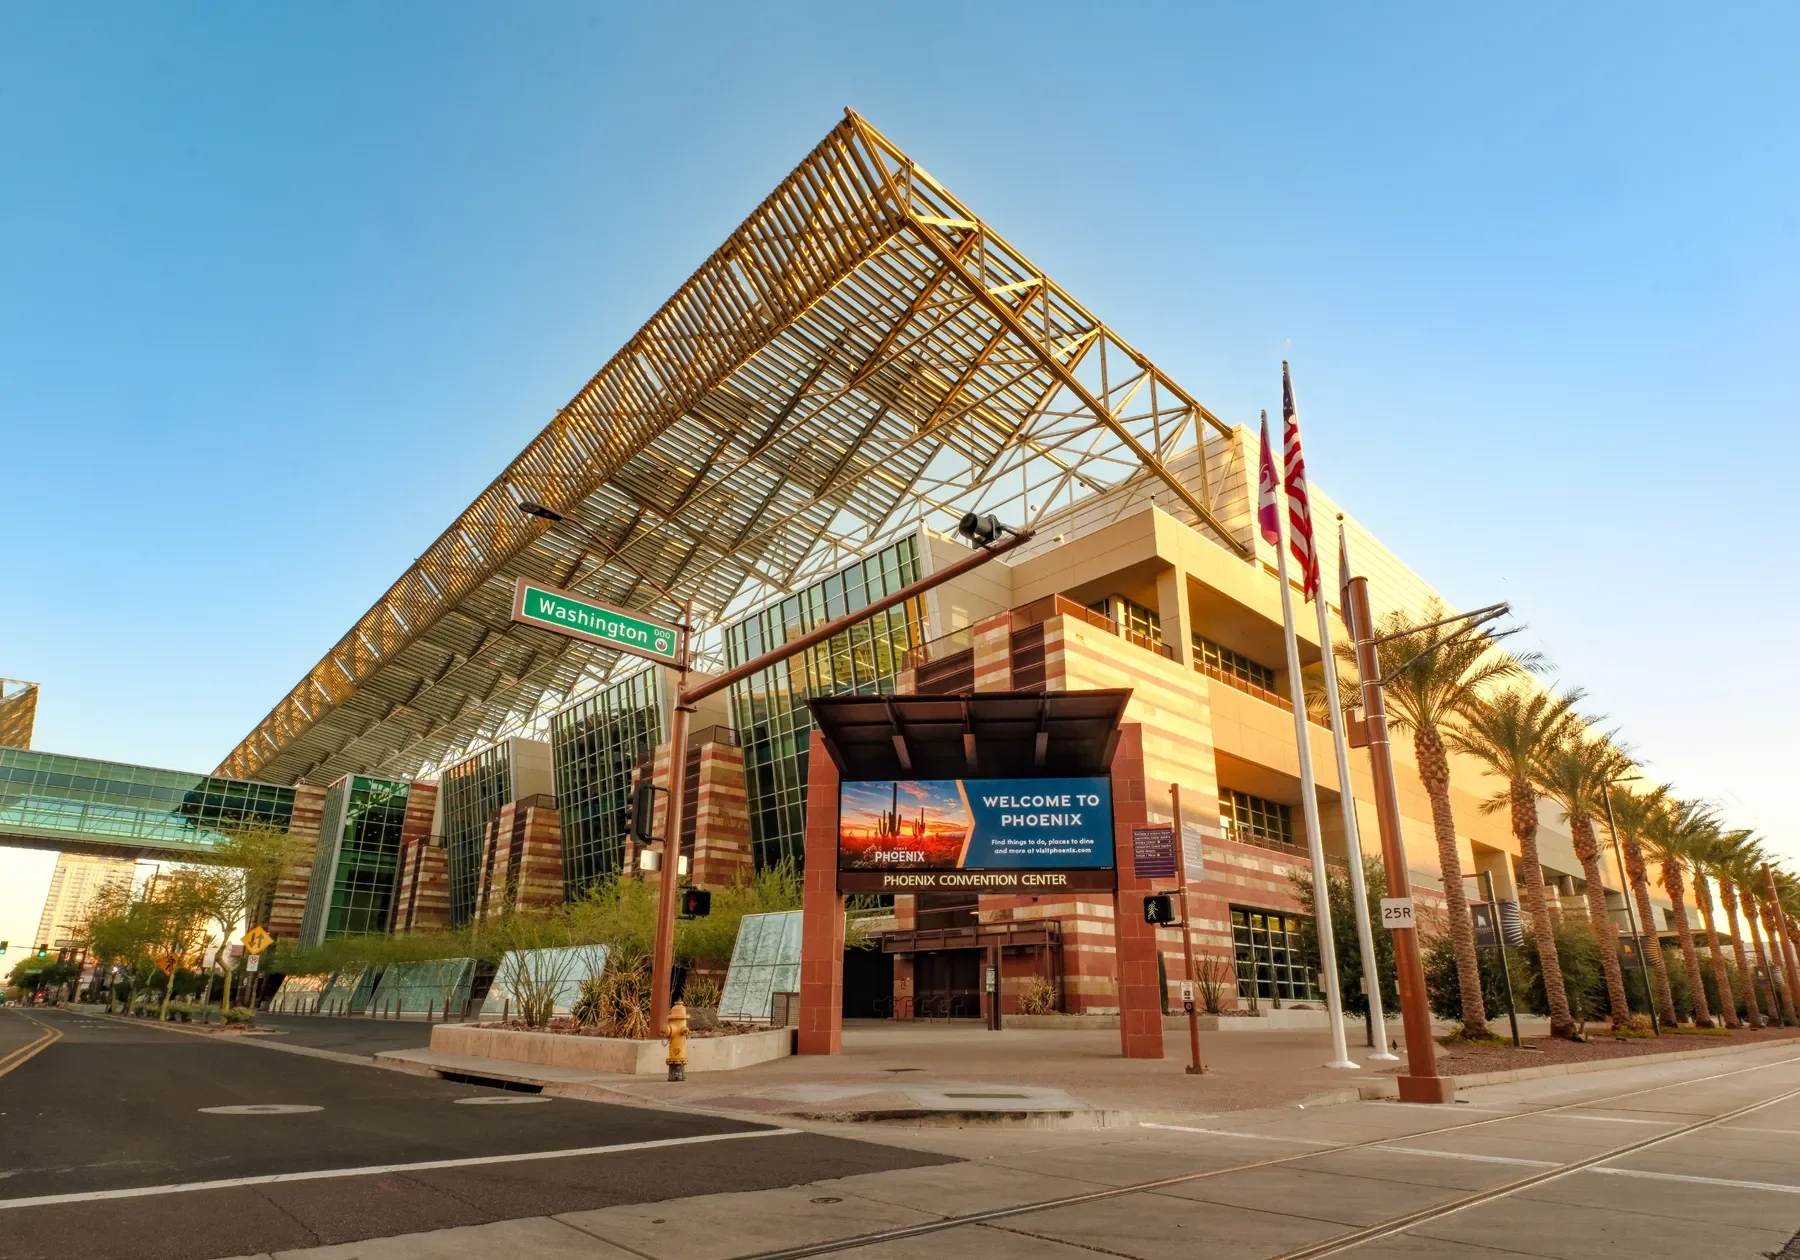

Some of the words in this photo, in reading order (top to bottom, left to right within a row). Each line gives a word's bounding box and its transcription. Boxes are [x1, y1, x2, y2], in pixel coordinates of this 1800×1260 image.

[539, 597, 648, 643] Washington
[653, 628, 671, 640] 000
[983, 795, 1071, 808] WELCOME
[1076, 794, 1100, 807] TO
[1001, 814, 1082, 827] PHOENIX
[1036, 838, 1047, 846] do,
[1048, 838, 1070, 846] places
[874, 851, 925, 863] PHOENIX
[1036, 847, 1092, 855] visitphoenix.com
[884, 875, 936, 886] PHOENIX
[939, 874, 1018, 886] CONVENTION
[1021, 874, 1067, 886] CENTER
[1384, 907, 1411, 919] 25R
